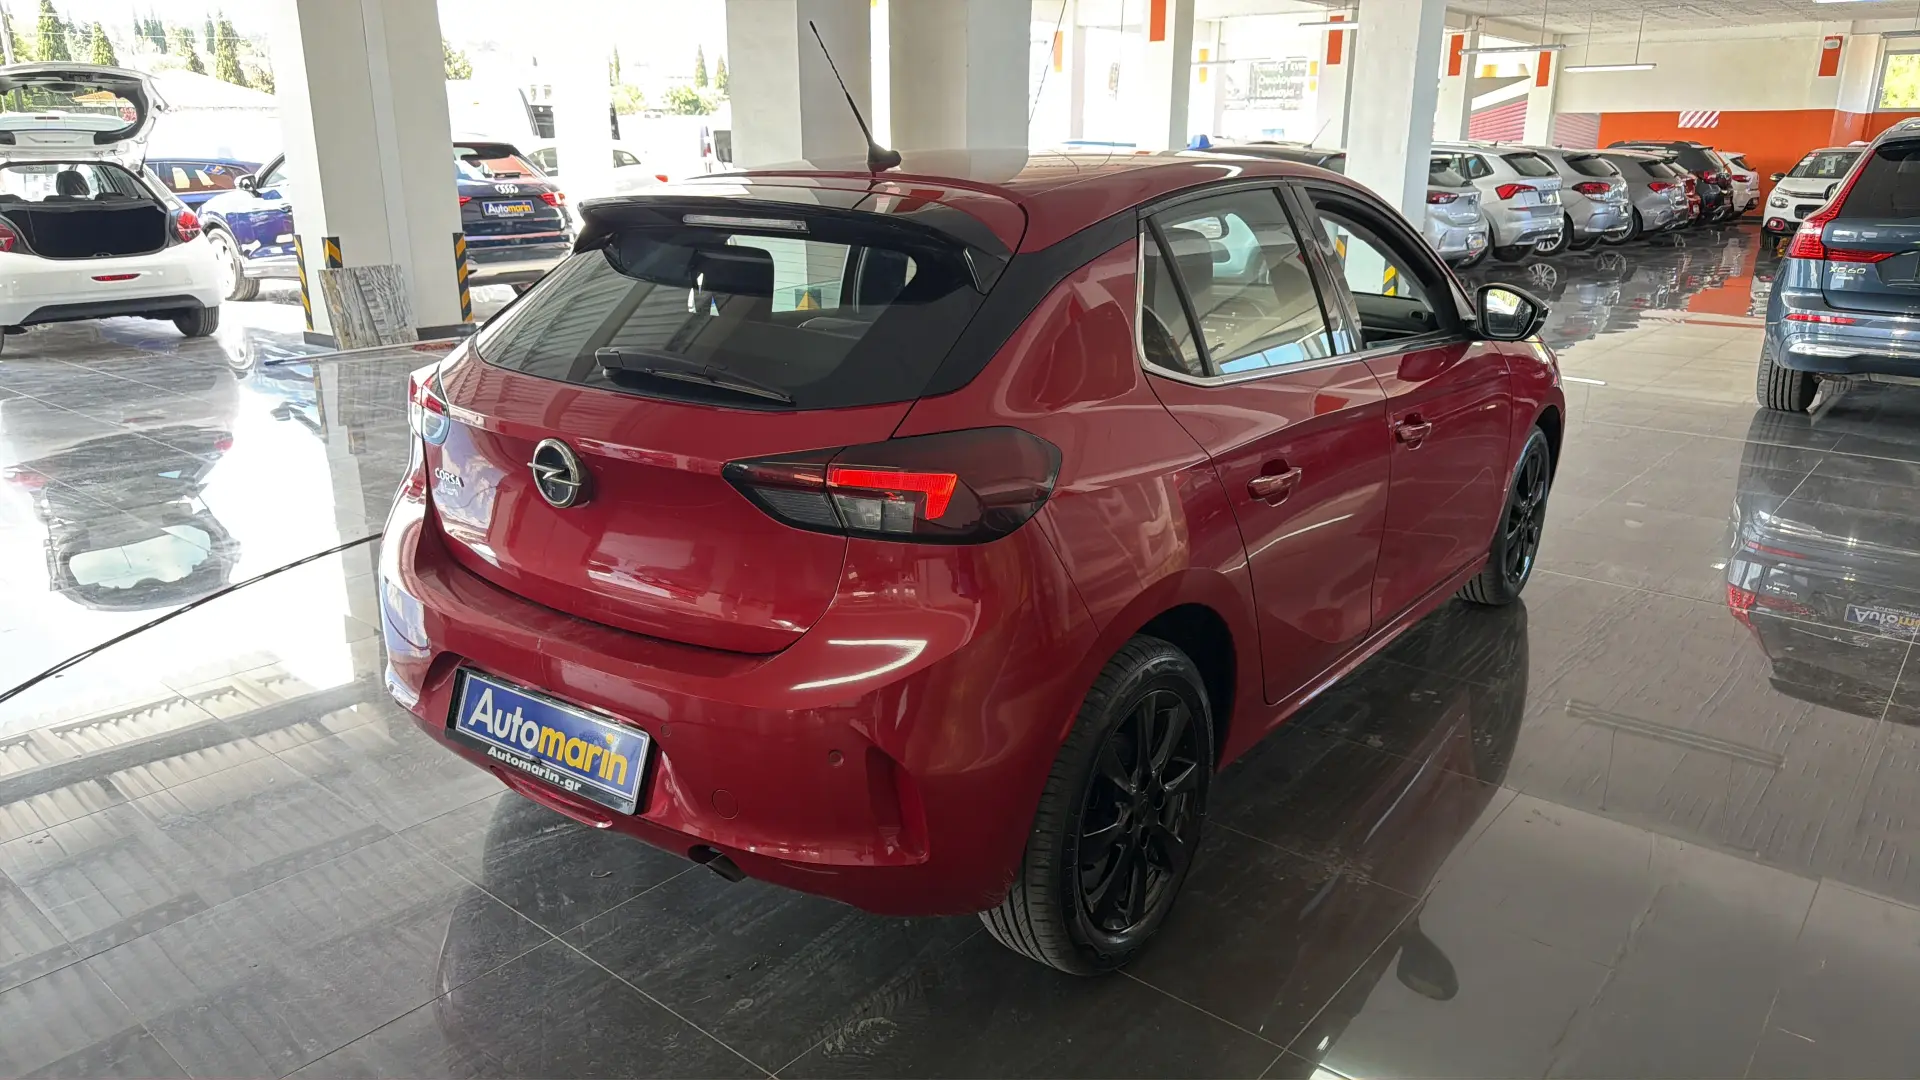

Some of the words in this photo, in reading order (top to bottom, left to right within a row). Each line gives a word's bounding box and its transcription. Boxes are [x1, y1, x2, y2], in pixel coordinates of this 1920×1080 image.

[488, 201, 531, 213] Automarin
[435, 466, 462, 488] CORSA
[468, 687, 629, 786] Automarin
[487, 745, 582, 792] Automarin.gr
